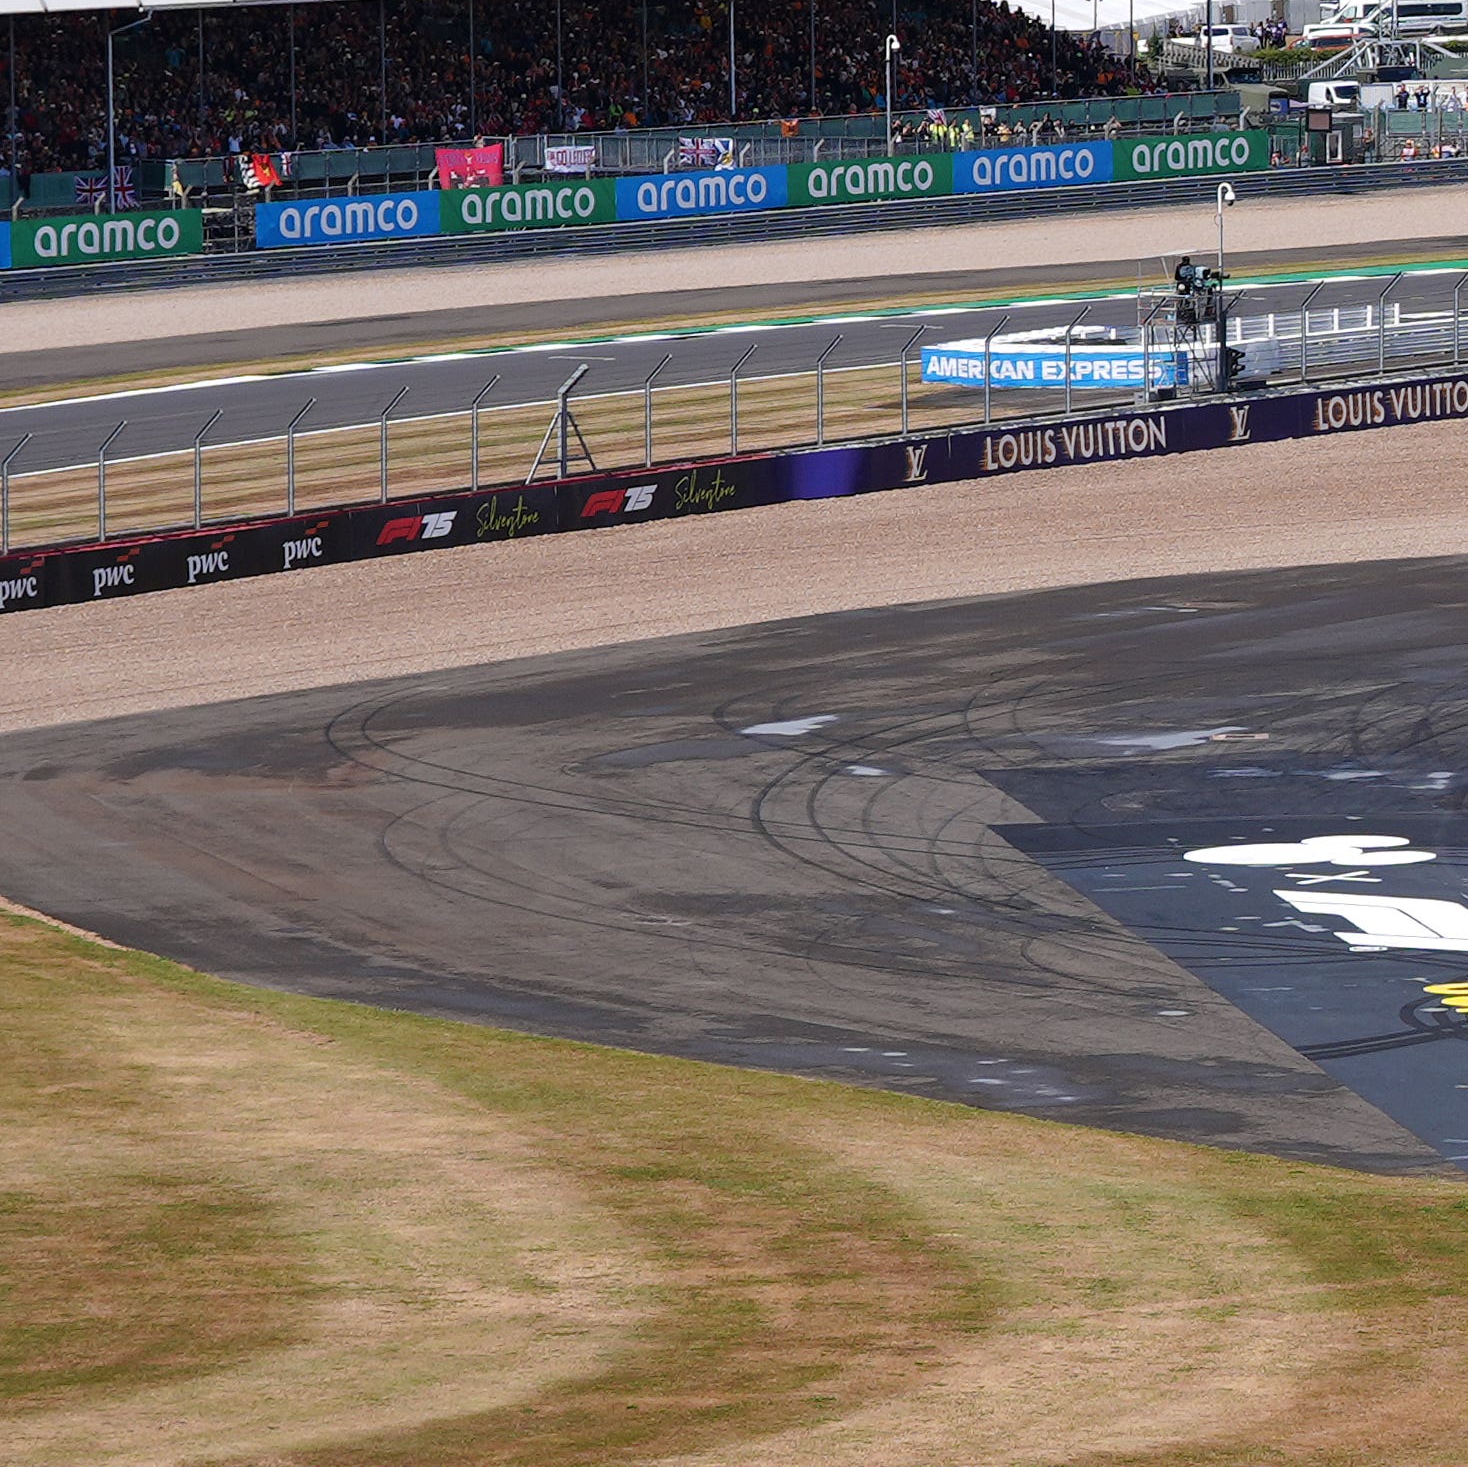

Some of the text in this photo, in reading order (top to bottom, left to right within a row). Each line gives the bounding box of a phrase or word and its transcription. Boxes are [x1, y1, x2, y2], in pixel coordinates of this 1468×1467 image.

[972, 148, 1094, 185] aramco
[1132, 136, 1249, 173] aramco
[637, 173, 767, 212] aramco
[807, 159, 933, 198] aramco
[279, 199, 418, 239] aramco
[460, 185, 595, 225] aramco
[34, 217, 180, 258] aramco
[1042, 359, 1162, 380] EXPRESS
[1316, 390, 1385, 430] LOUIS
[986, 416, 1167, 471] LOUIS VUITTON
[580, 489, 625, 517] F1
[376, 516, 422, 545] F1
[186, 550, 230, 584] pwc
[282, 536, 323, 570] pwc
[0, 576, 38, 609] pwc
[92, 563, 136, 597] pwc
